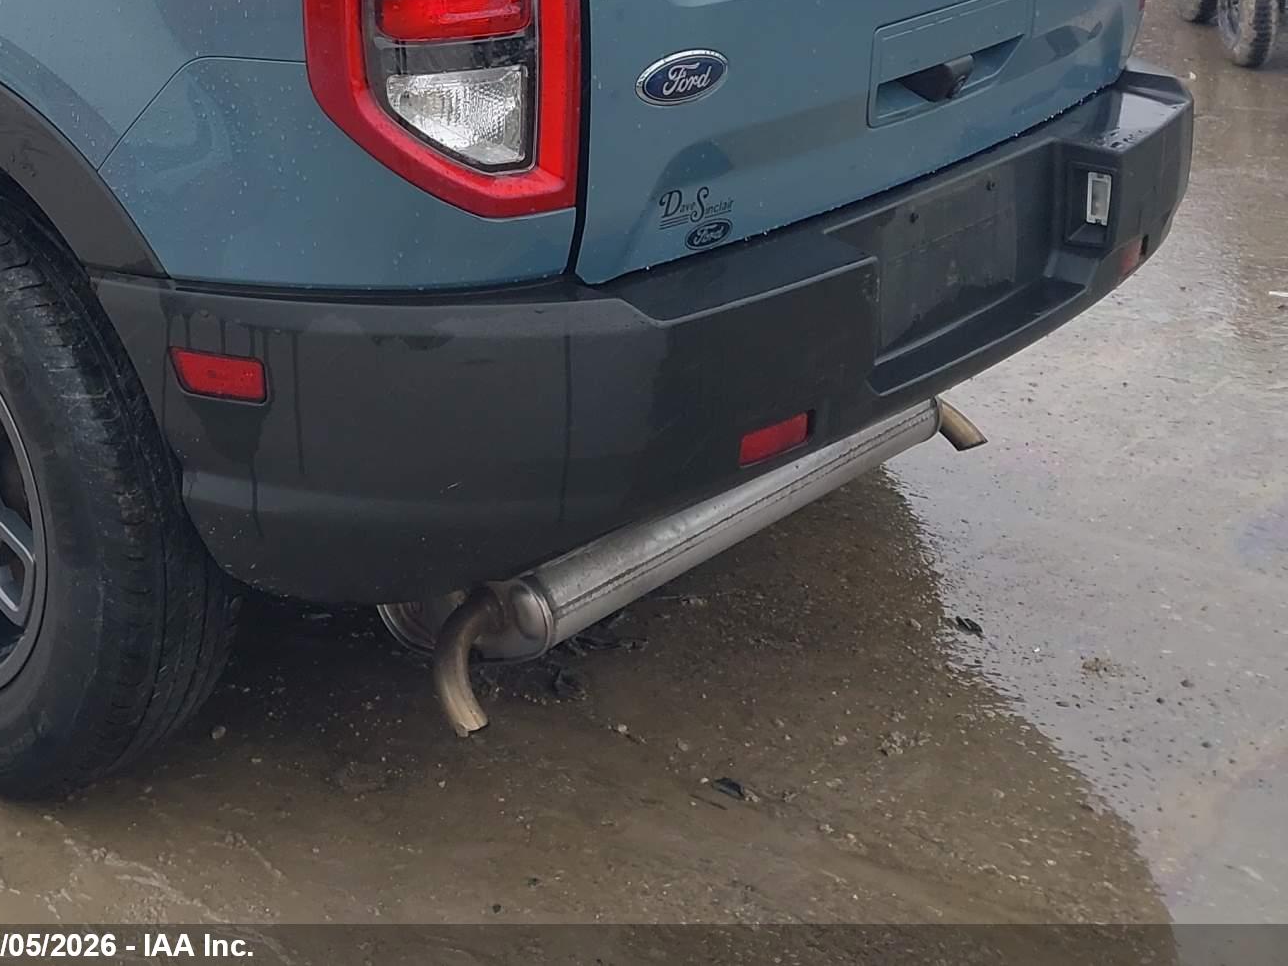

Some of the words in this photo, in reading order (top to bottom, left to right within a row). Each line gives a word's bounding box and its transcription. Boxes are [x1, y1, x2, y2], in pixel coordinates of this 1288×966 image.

[661, 61, 713, 97] Ford
[659, 189, 696, 219] Dave
[689, 186, 735, 223] Sinclair
[691, 223, 726, 245] Ford
